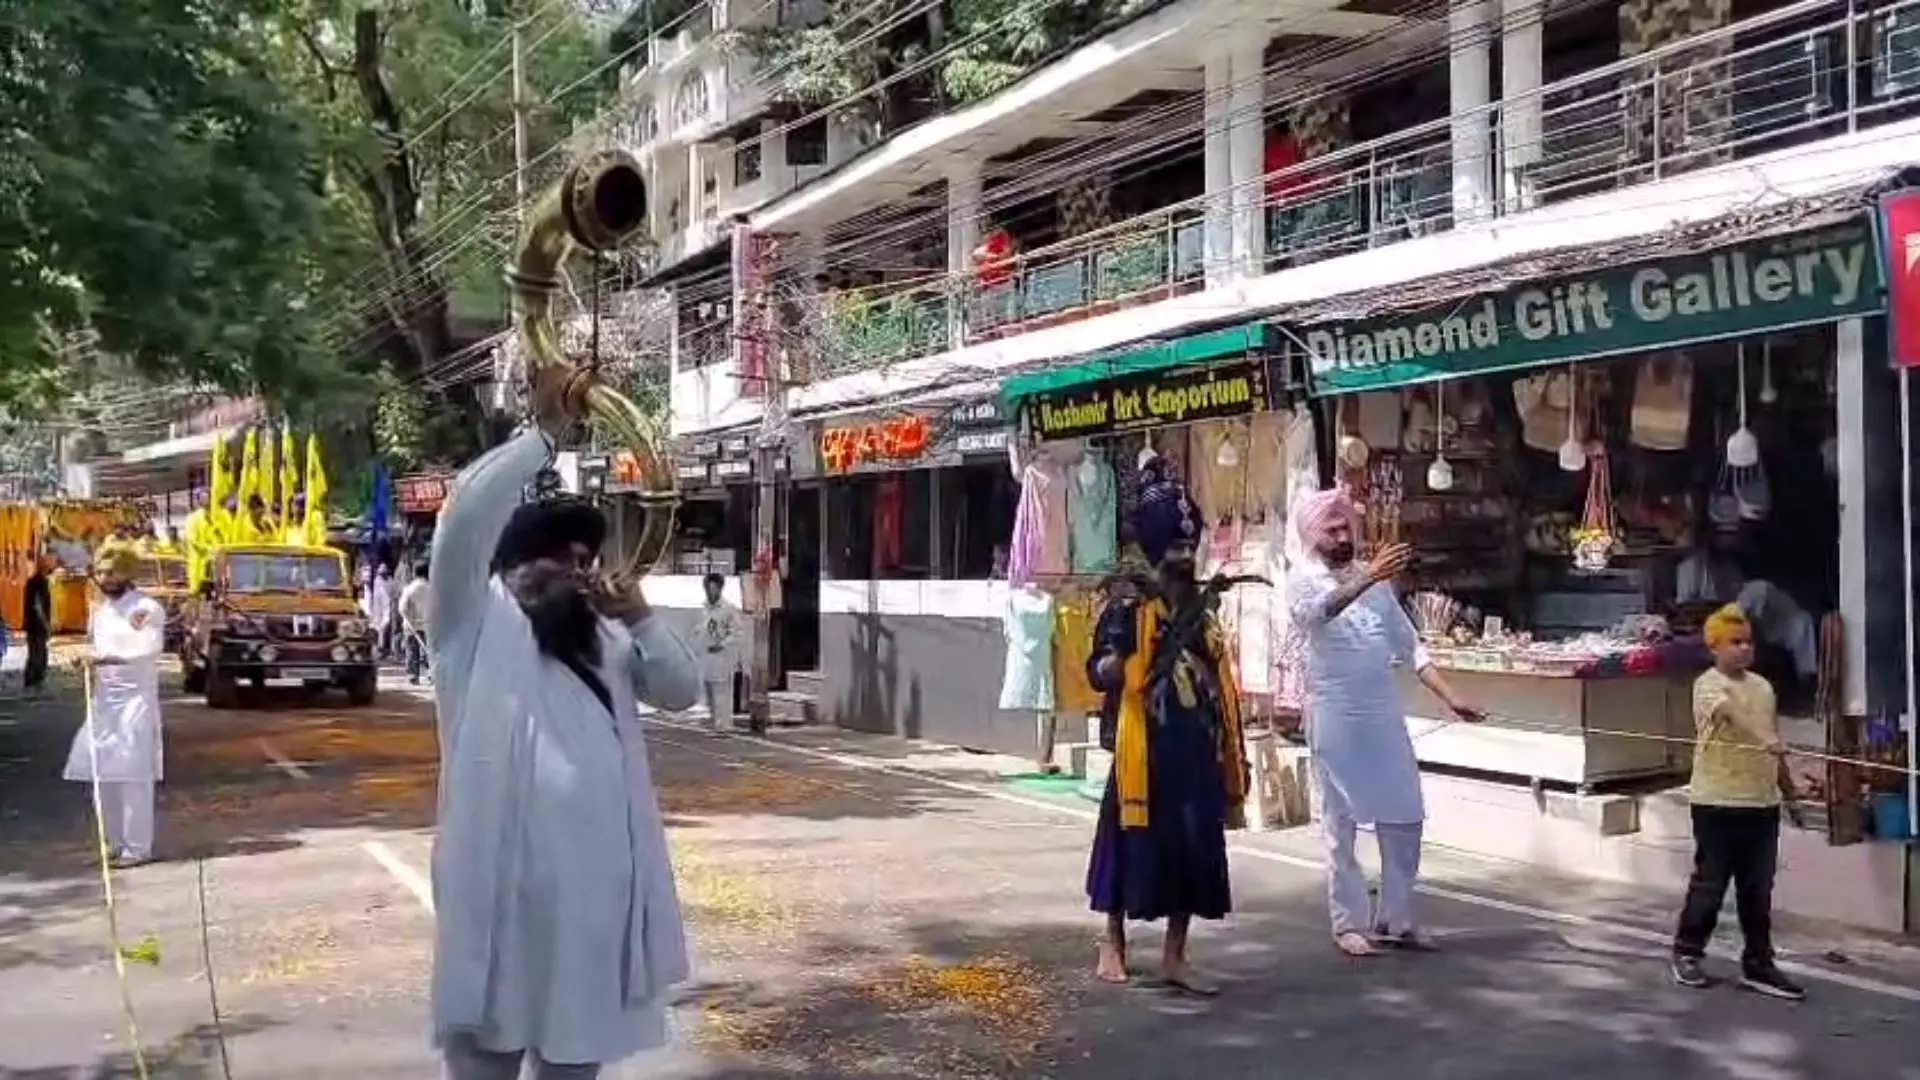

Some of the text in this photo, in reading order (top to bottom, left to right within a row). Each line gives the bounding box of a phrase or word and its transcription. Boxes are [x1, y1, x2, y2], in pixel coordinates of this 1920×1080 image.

[1307, 299, 1500, 374] Diamond
[1513, 281, 1614, 341] Gift
[1630, 242, 1866, 322] Gallery
[1113, 387, 1143, 420] Art
[1147, 371, 1250, 419] Emporium
